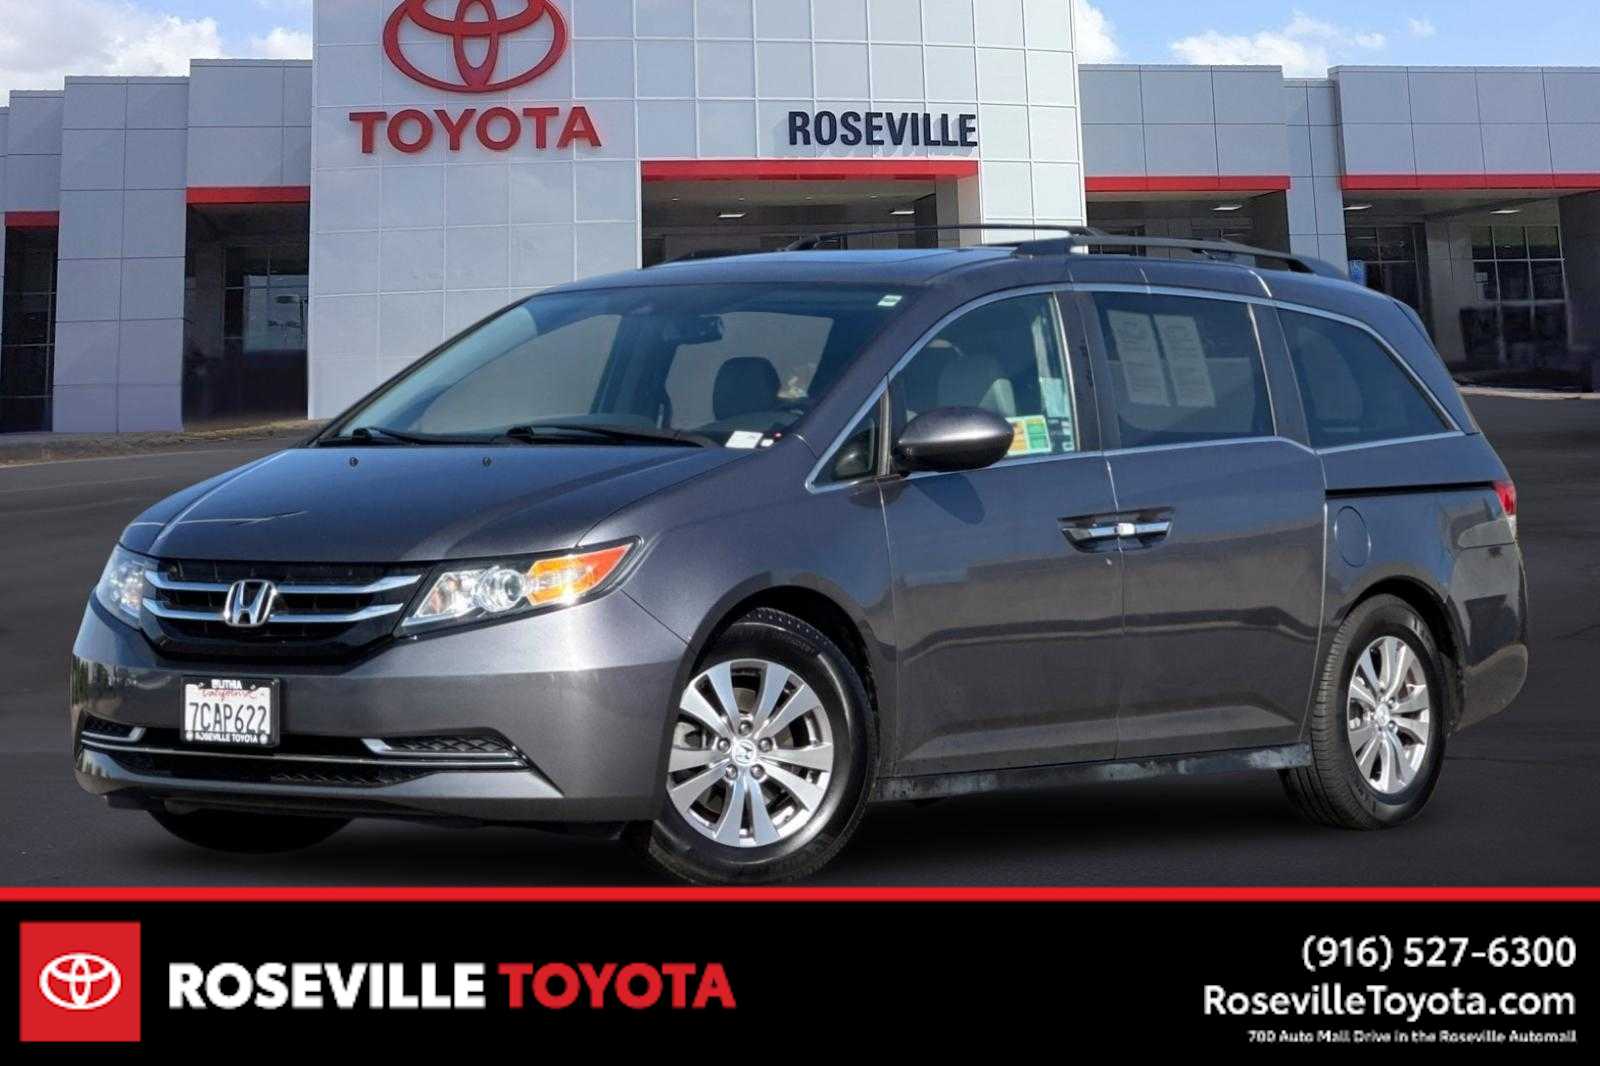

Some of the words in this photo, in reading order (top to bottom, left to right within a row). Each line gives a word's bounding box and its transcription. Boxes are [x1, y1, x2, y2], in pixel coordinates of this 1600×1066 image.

[349, 106, 602, 154] TOYOTA
[788, 110, 978, 147] ROSEVILLE
[189, 702, 267, 734] 7CAP622
[231, 733, 258, 743] TOYOTA
